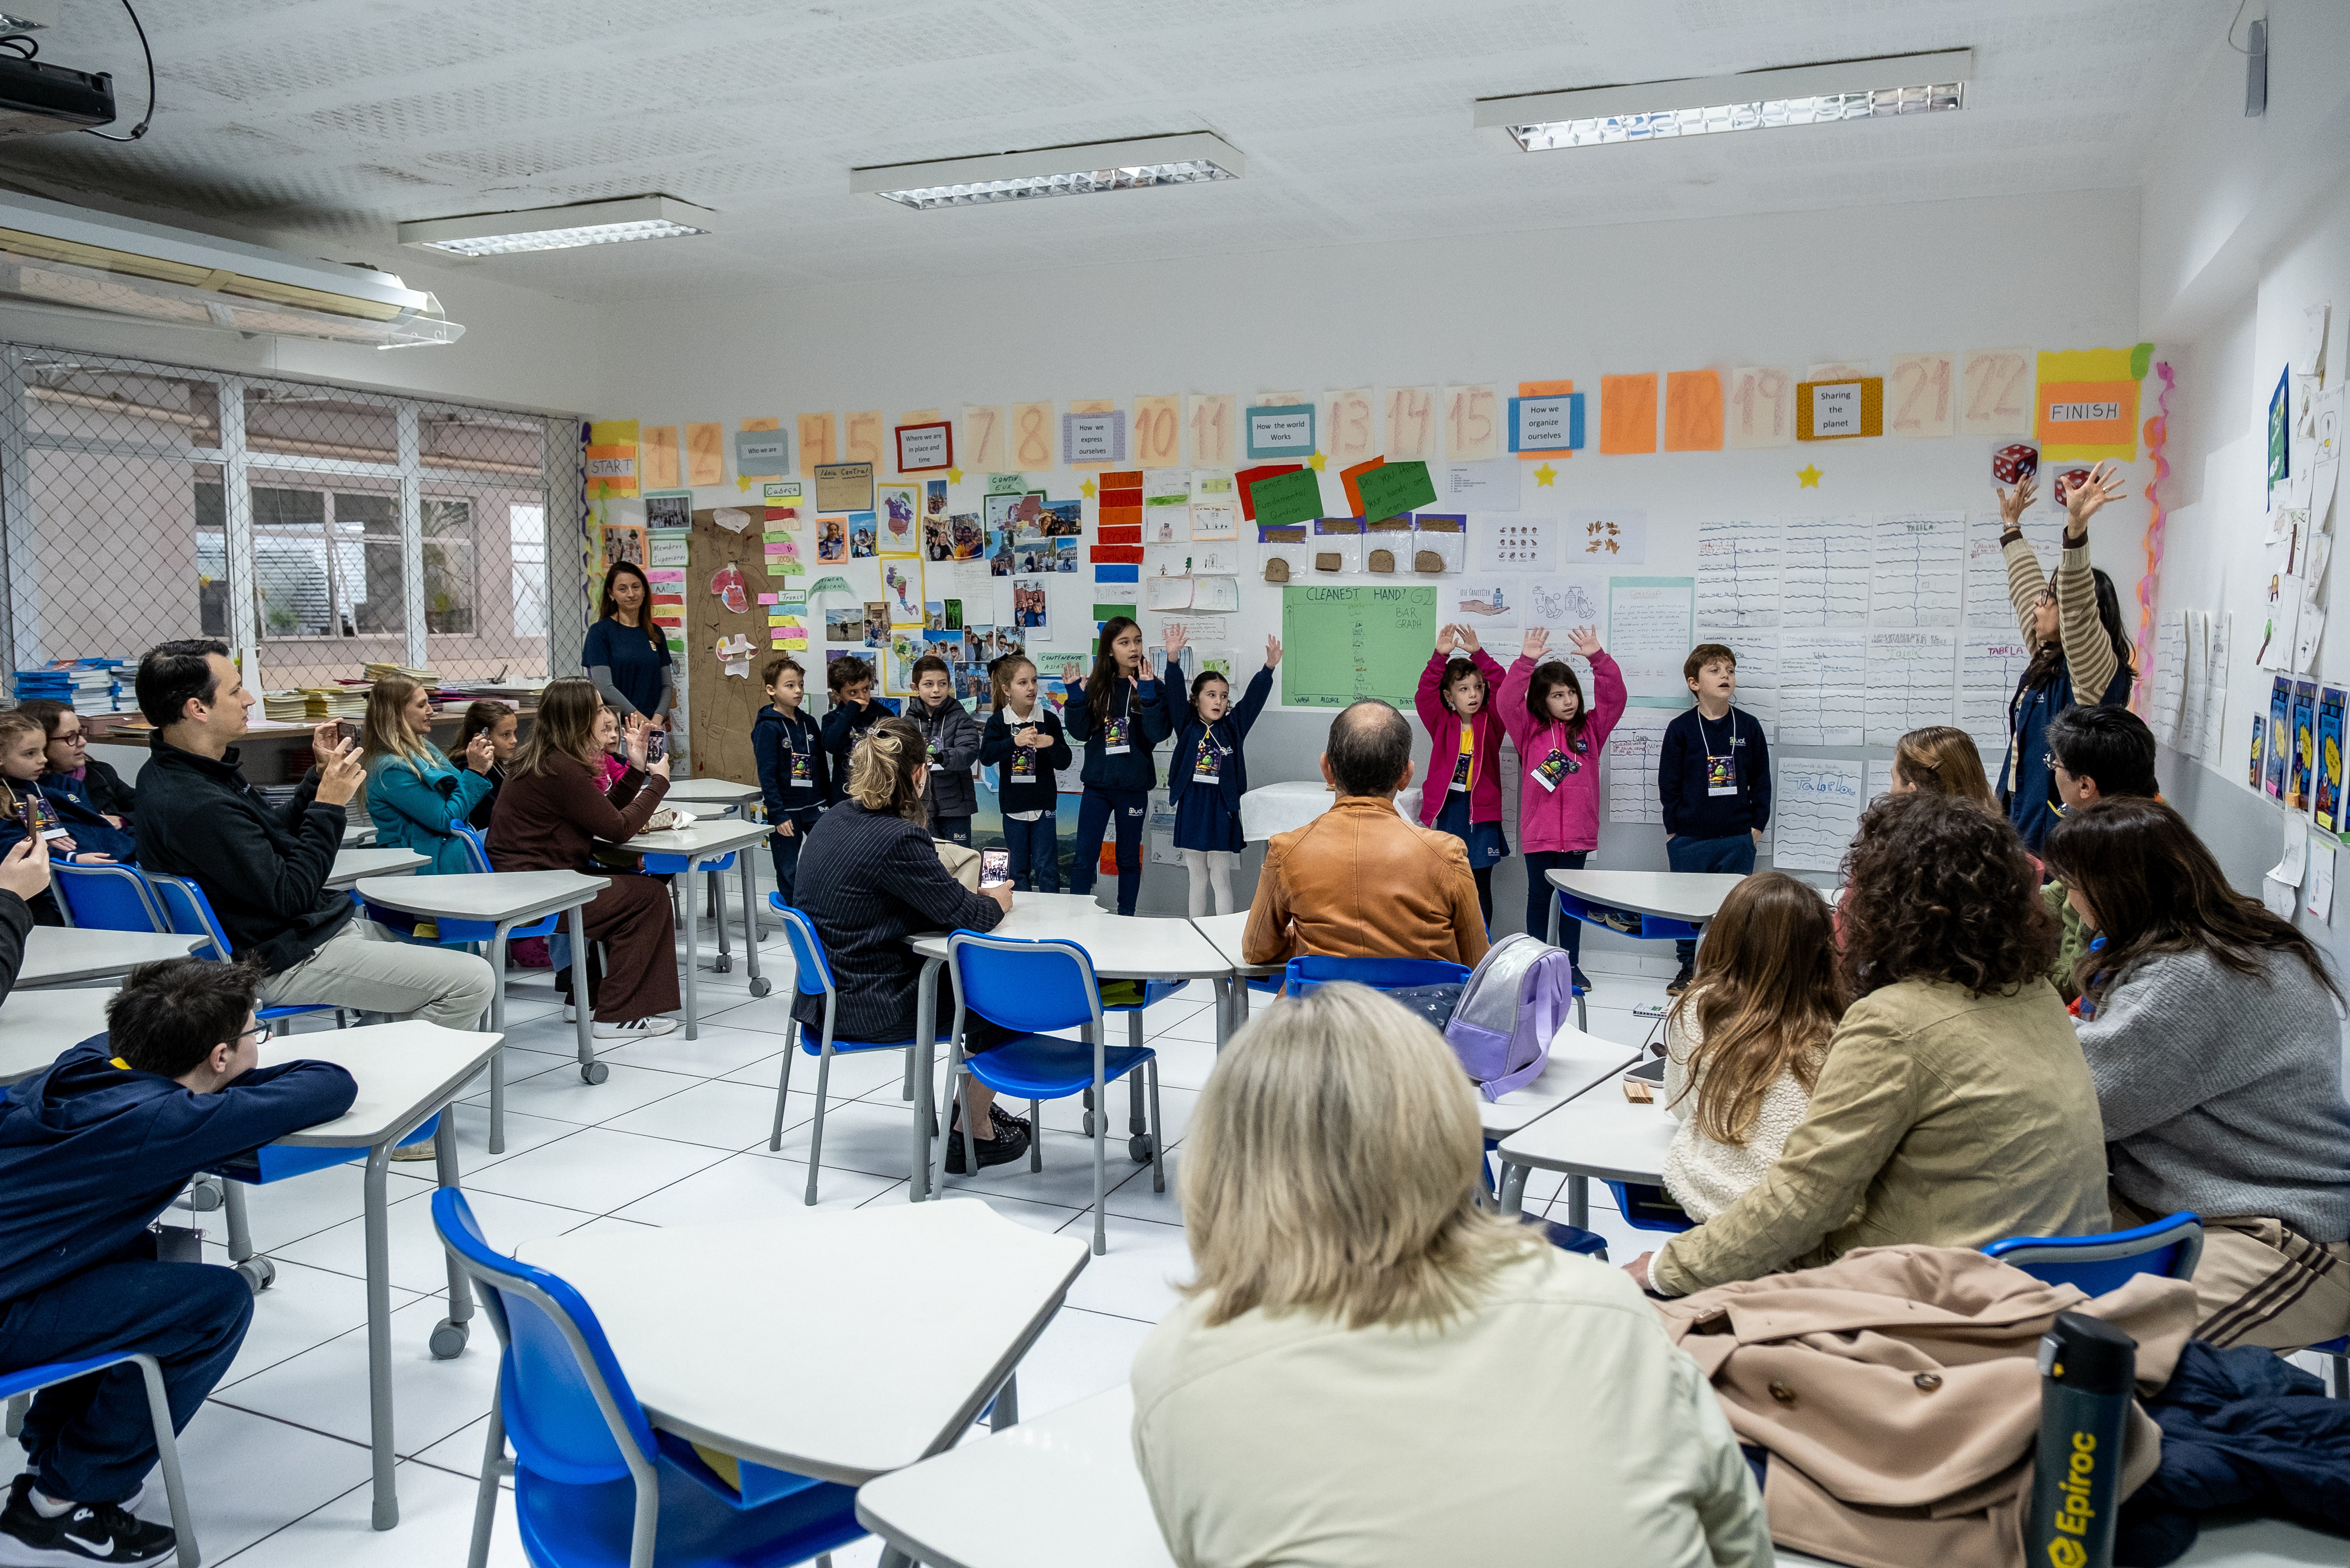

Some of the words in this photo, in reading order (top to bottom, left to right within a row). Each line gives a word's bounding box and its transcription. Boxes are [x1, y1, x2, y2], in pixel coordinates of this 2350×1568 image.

[1821, 391, 1851, 400] Sharing
[1892, 359, 1950, 431] 21
[1965, 355, 2027, 420] 22
[1733, 369, 1786, 436] 19
[2052, 403, 2118, 420] FINISH
[1286, 420, 1305, 429] world
[1326, 400, 1369, 453] 13
[1388, 390, 1431, 456] 14
[1451, 391, 1493, 451] 15
[1529, 419, 1559, 427] organize
[1823, 420, 1849, 429] planet
[969, 411, 995, 464] 7
[1018, 408, 1049, 466] 8
[1135, 408, 1177, 459] 10
[1191, 402, 1225, 461] 11
[1270, 433, 1291, 441] Works
[1528, 432, 1561, 440] ourselves
[693, 425, 717, 476] 2
[591, 459, 632, 474] START
[992, 475, 1019, 484] CONTIN
[1252, 480, 1281, 494] Science
[1358, 477, 1372, 489] Do
[1378, 470, 1394, 485] you
[1386, 484, 1407, 498] hands
[1414, 477, 1426, 487] are
[767, 487, 797, 496] Cabeça
[1255, 488, 1306, 511] Fundamental
[1381, 498, 1407, 516] clean?
[654, 543, 682, 552] Membros
[1306, 587, 1360, 601] CLEANEST
[1374, 589, 1406, 600] HAND?
[1410, 588, 1434, 606] G2
[1396, 607, 1418, 618] BAR
[1396, 619, 1422, 630] GRAPH
[1988, 646, 2023, 656] TABELA
[1784, 775, 1856, 796] Tabela
[2055, 1431, 2096, 1536] Epiroc
